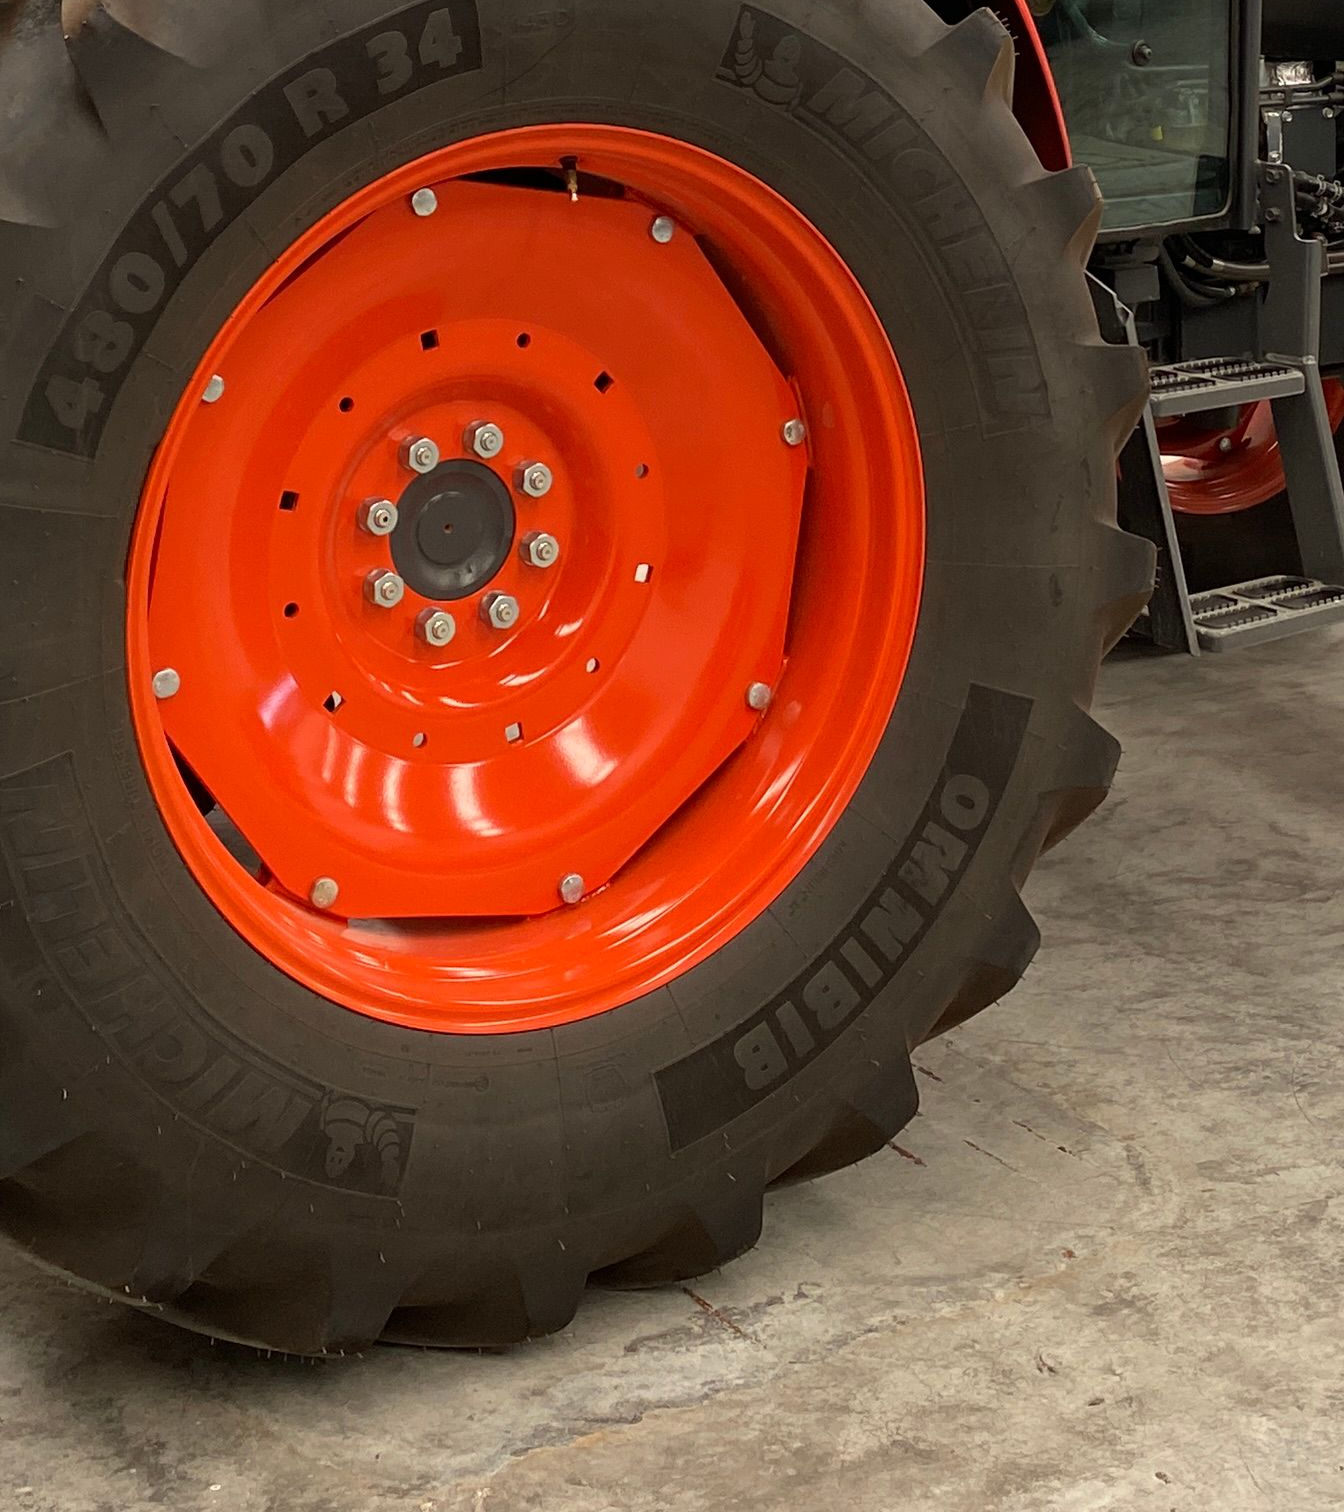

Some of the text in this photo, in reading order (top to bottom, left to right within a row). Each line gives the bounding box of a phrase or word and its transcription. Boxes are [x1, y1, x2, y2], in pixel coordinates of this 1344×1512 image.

[43, 6, 462, 429] 480/70 R 34
[733, 773, 991, 1090] OMNIBIB
